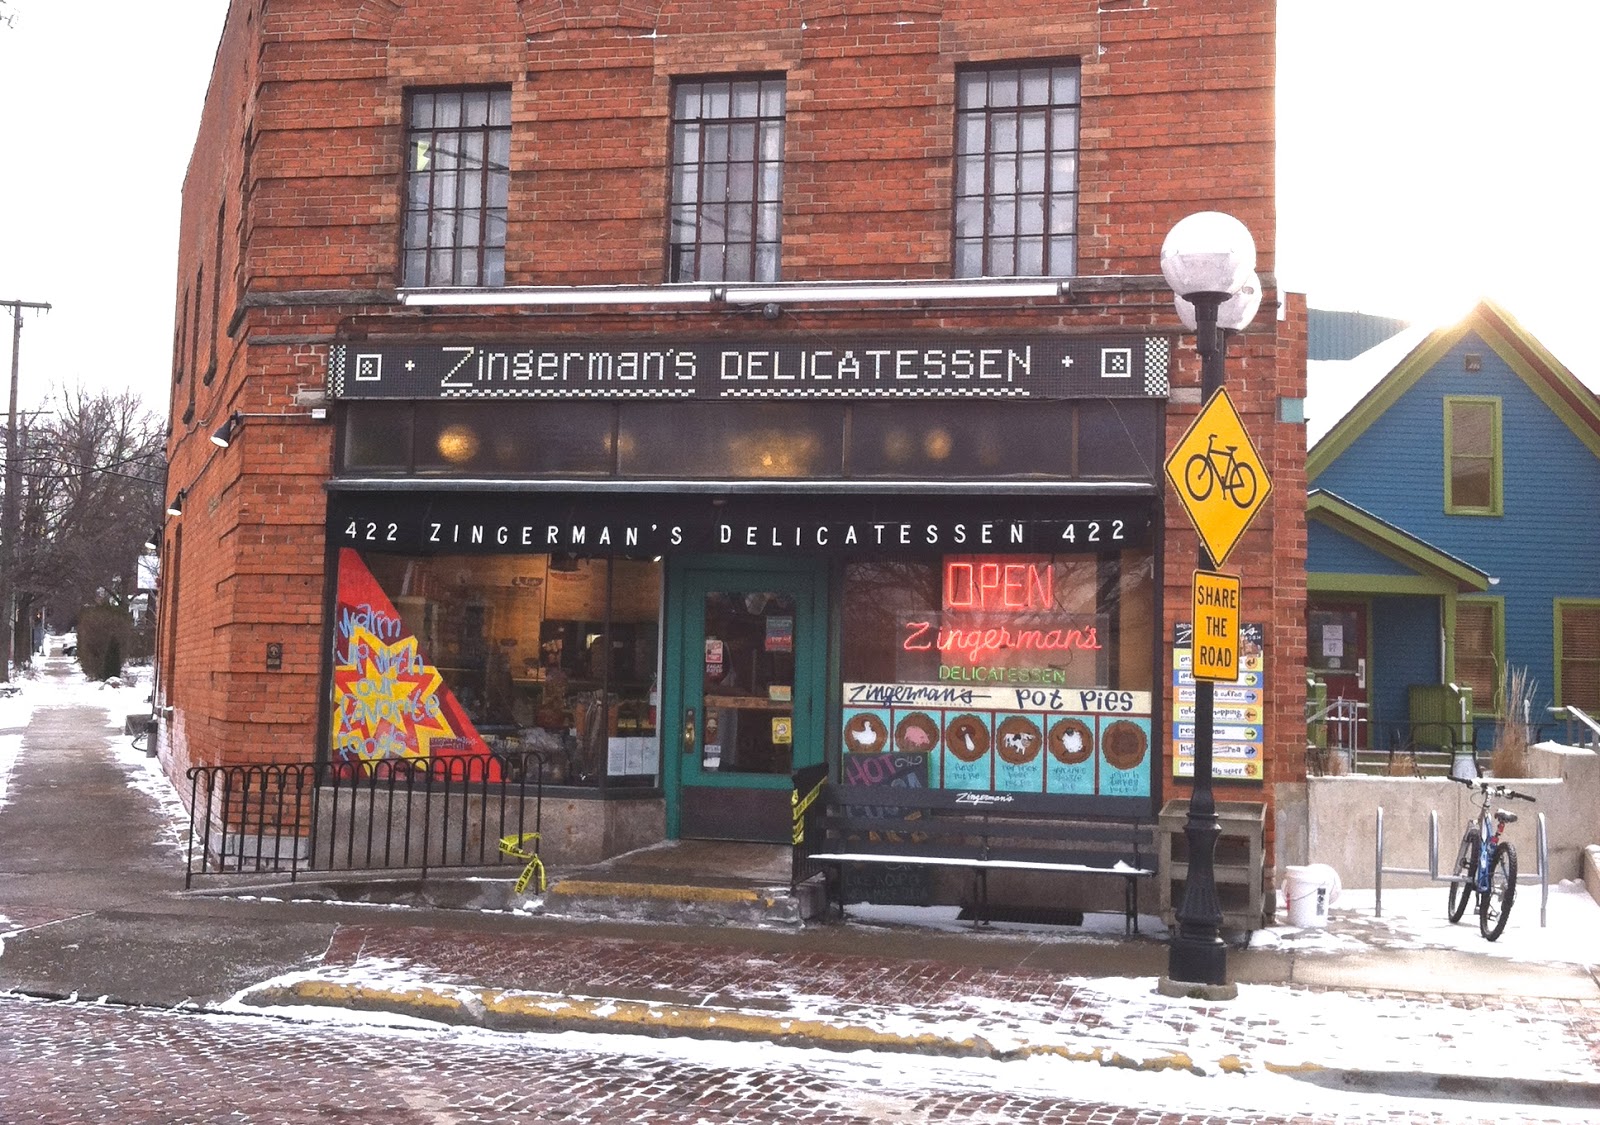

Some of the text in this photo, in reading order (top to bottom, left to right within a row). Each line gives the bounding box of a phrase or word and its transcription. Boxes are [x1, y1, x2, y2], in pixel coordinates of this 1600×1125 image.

[440, 345, 1031, 387] Zingerman's DELICATESSEN
[345, 520, 1124, 546] 422 ZINGERMAN'S DELICATESSEN 422
[948, 562, 1053, 609] OPEN
[1198, 585, 1237, 609] SHARE
[1206, 616, 1228, 638] THE
[903, 622, 1102, 662] Zingerman's
[1200, 646, 1232, 668] ROAD
[939, 666, 1066, 683] DELICATESSEN
[356, 678, 398, 697] our
[849, 683, 992, 708] Zingerman's
[847, 754, 896, 787] HOT
